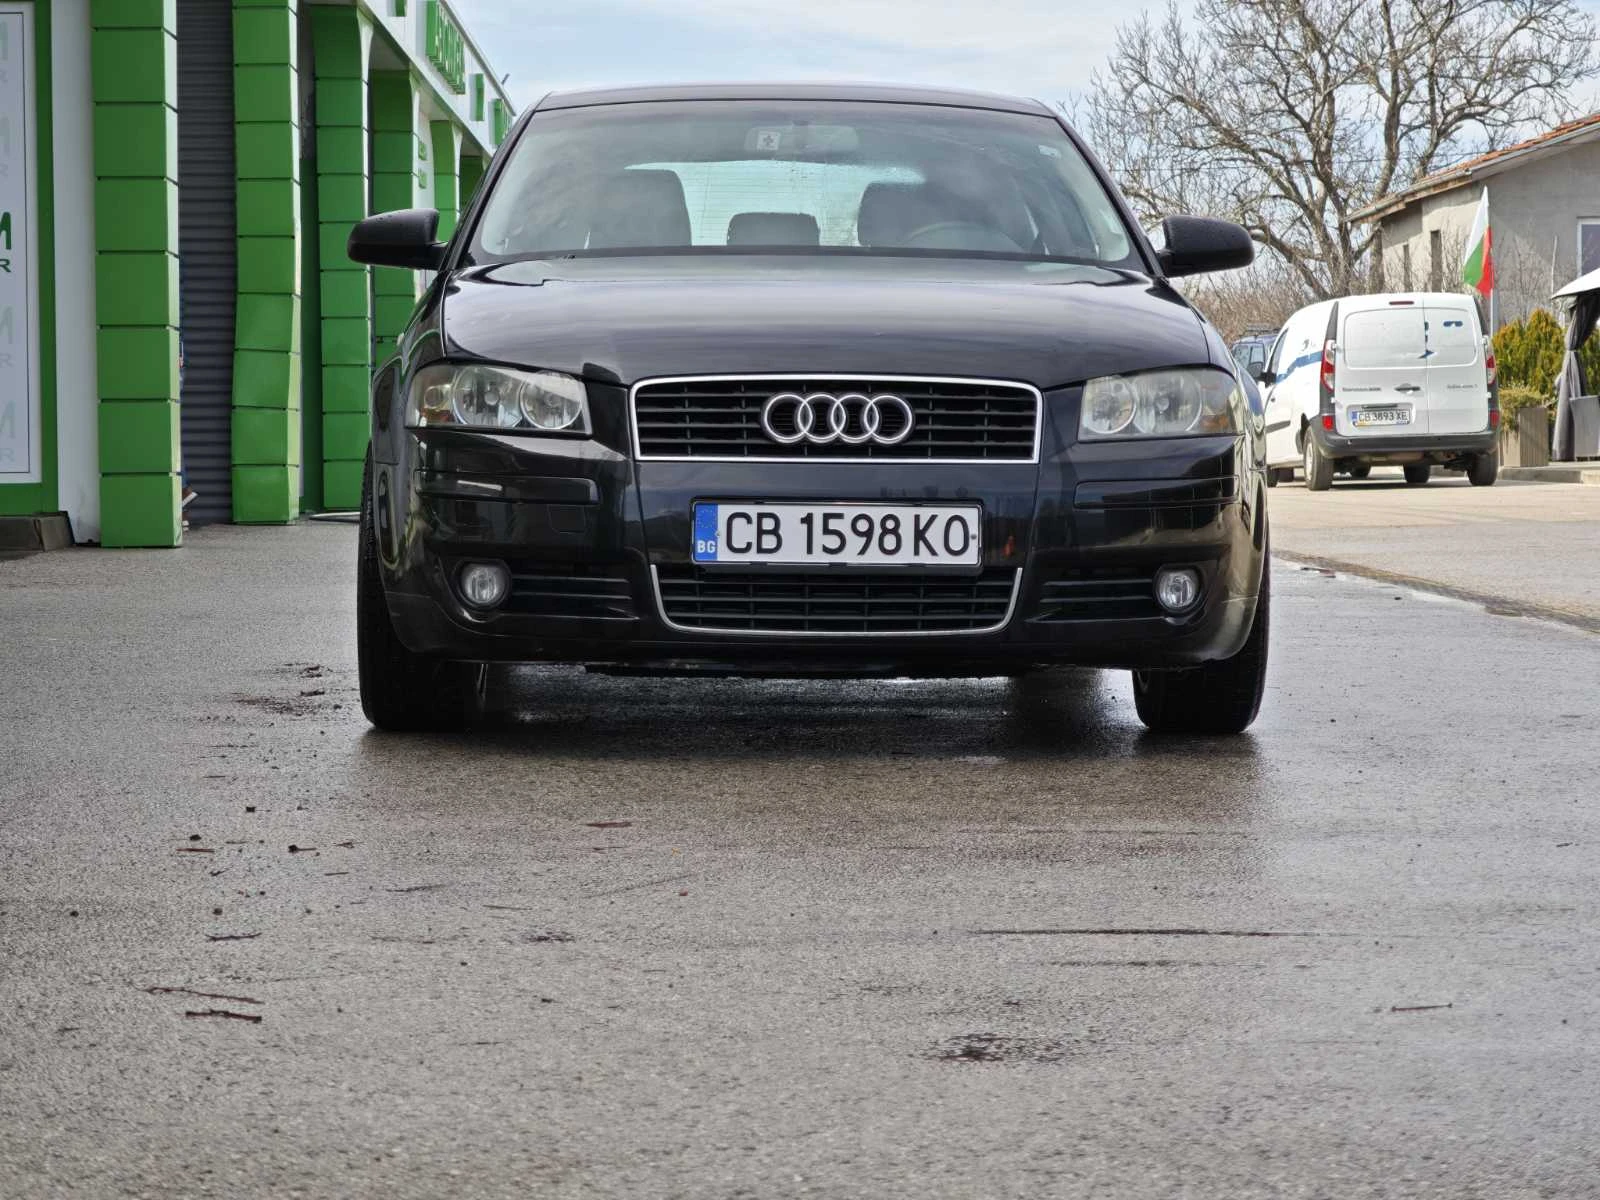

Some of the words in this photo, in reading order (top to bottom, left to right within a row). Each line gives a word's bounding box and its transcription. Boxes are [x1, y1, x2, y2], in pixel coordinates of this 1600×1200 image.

[1358, 412, 1371, 422] CB
[726, 511, 783, 554] CB
[800, 512, 902, 556] 1598
[913, 514, 970, 557] KO
[697, 540, 716, 553] BG
